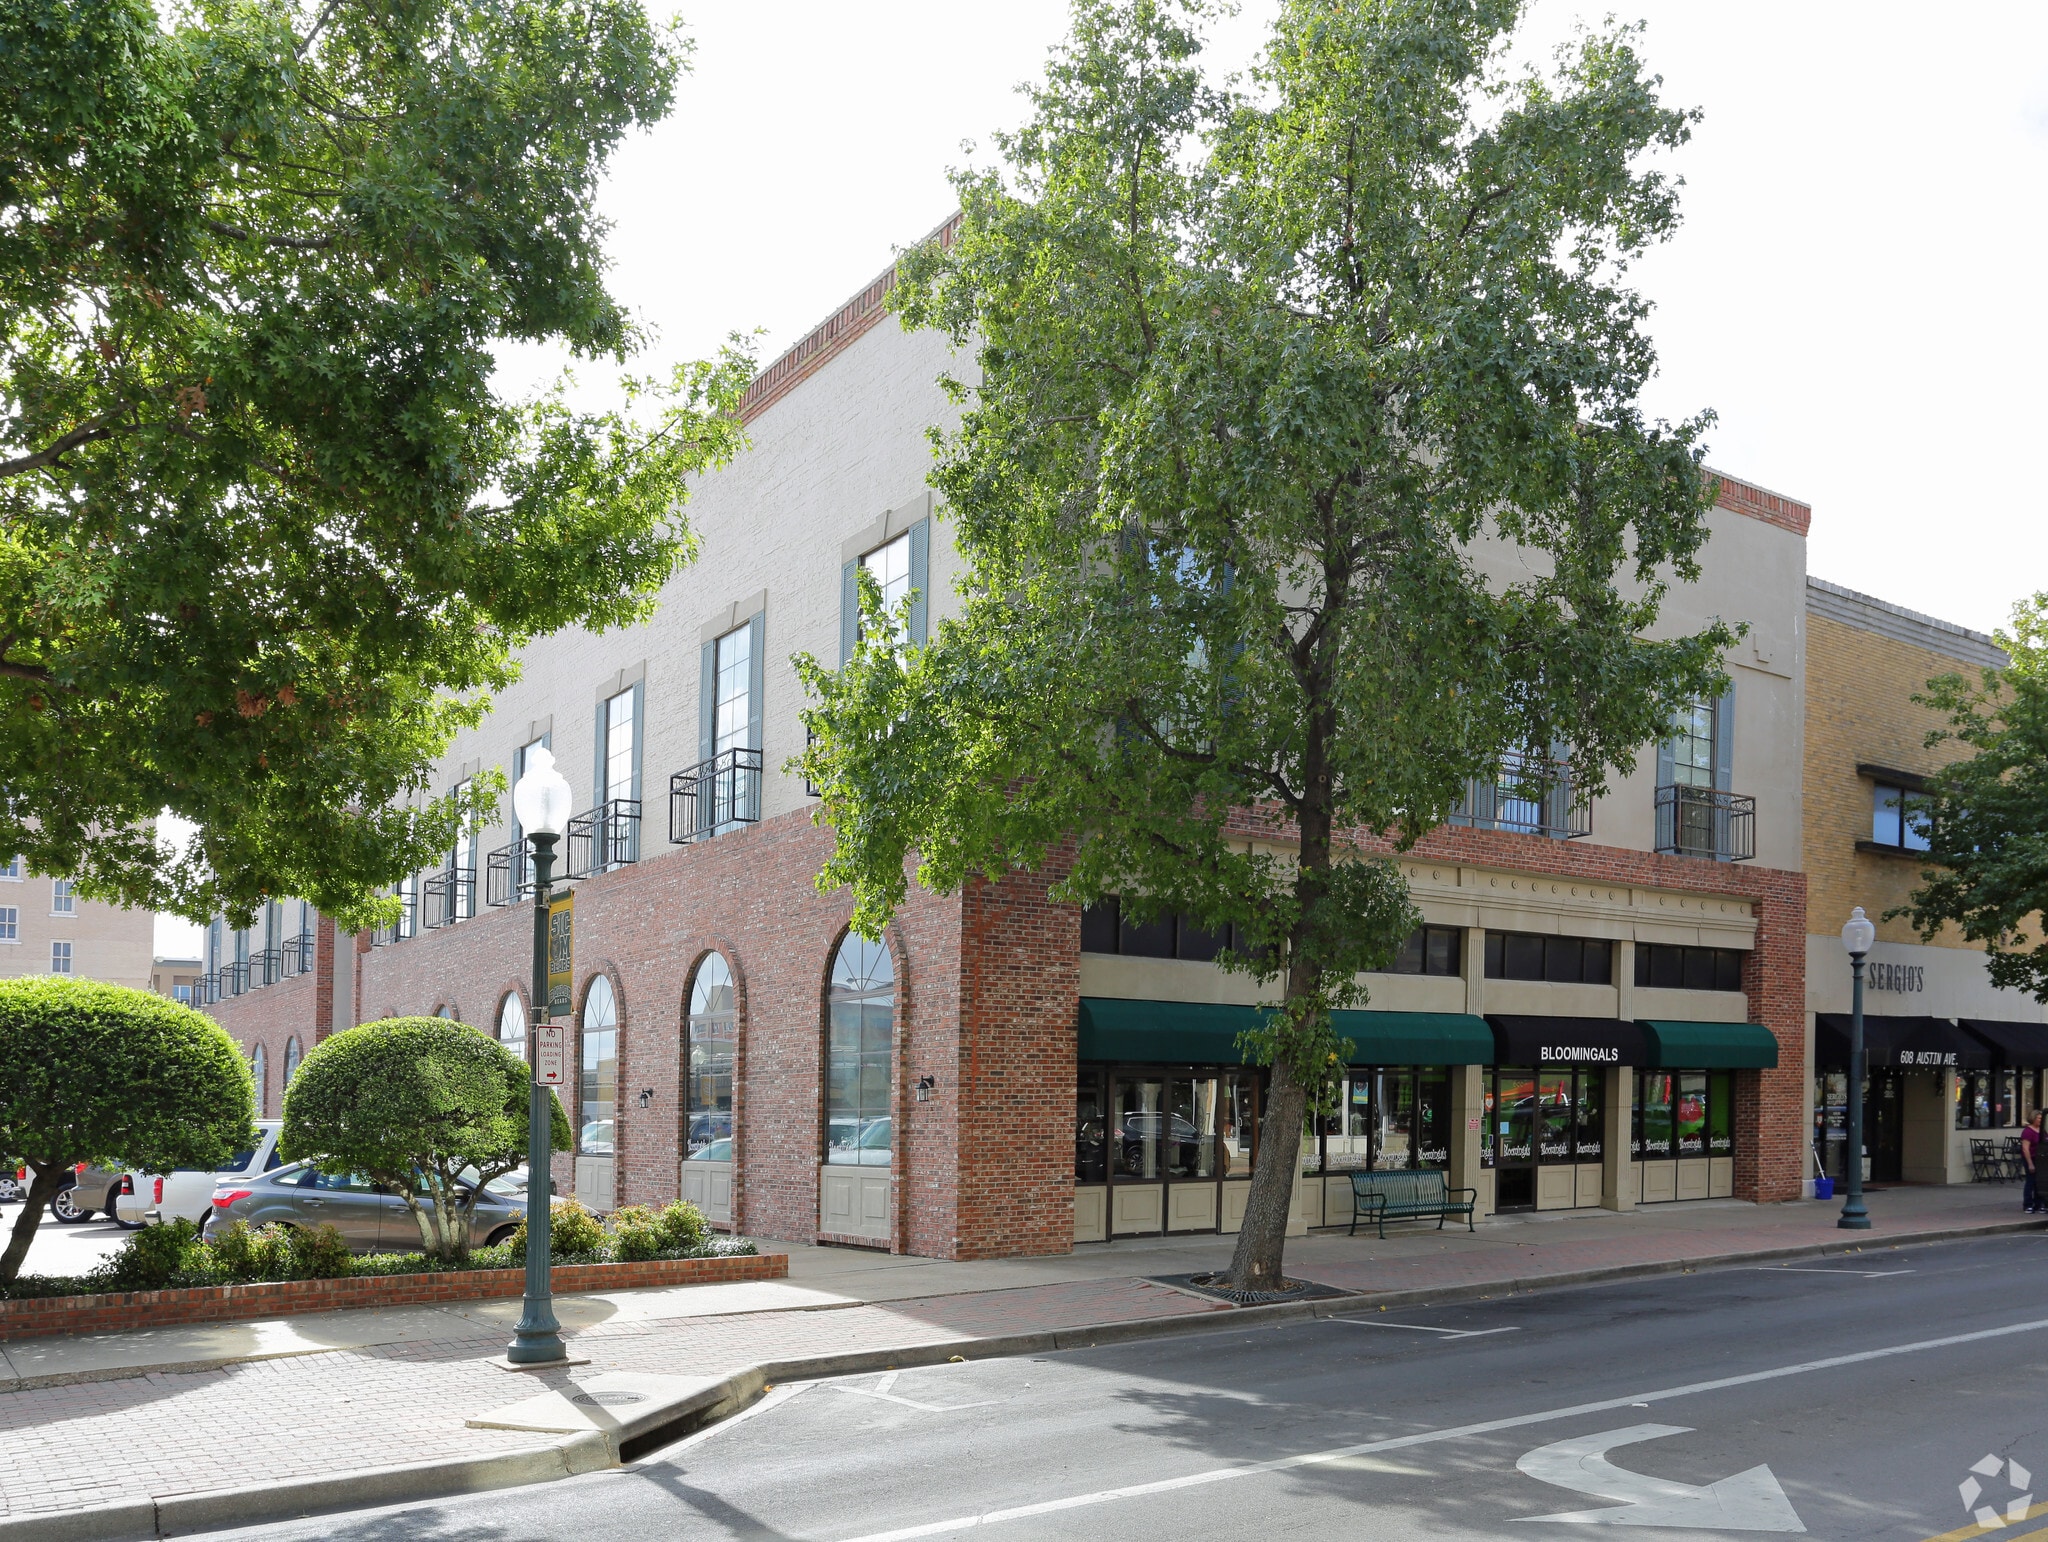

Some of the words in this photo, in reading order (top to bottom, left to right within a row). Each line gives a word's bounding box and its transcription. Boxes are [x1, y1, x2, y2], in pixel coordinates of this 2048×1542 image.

[1869, 962, 1924, 994] SERGIO'S
[546, 1030, 556, 1038] NO
[540, 1041, 562, 1049] PARKING
[1541, 1046, 1618, 1061] BLOOMINGALS
[1900, 1050, 1914, 1064] 608
[1916, 1051, 1942, 1065] AUSTIN
[1943, 1052, 1959, 1066] AVE.
